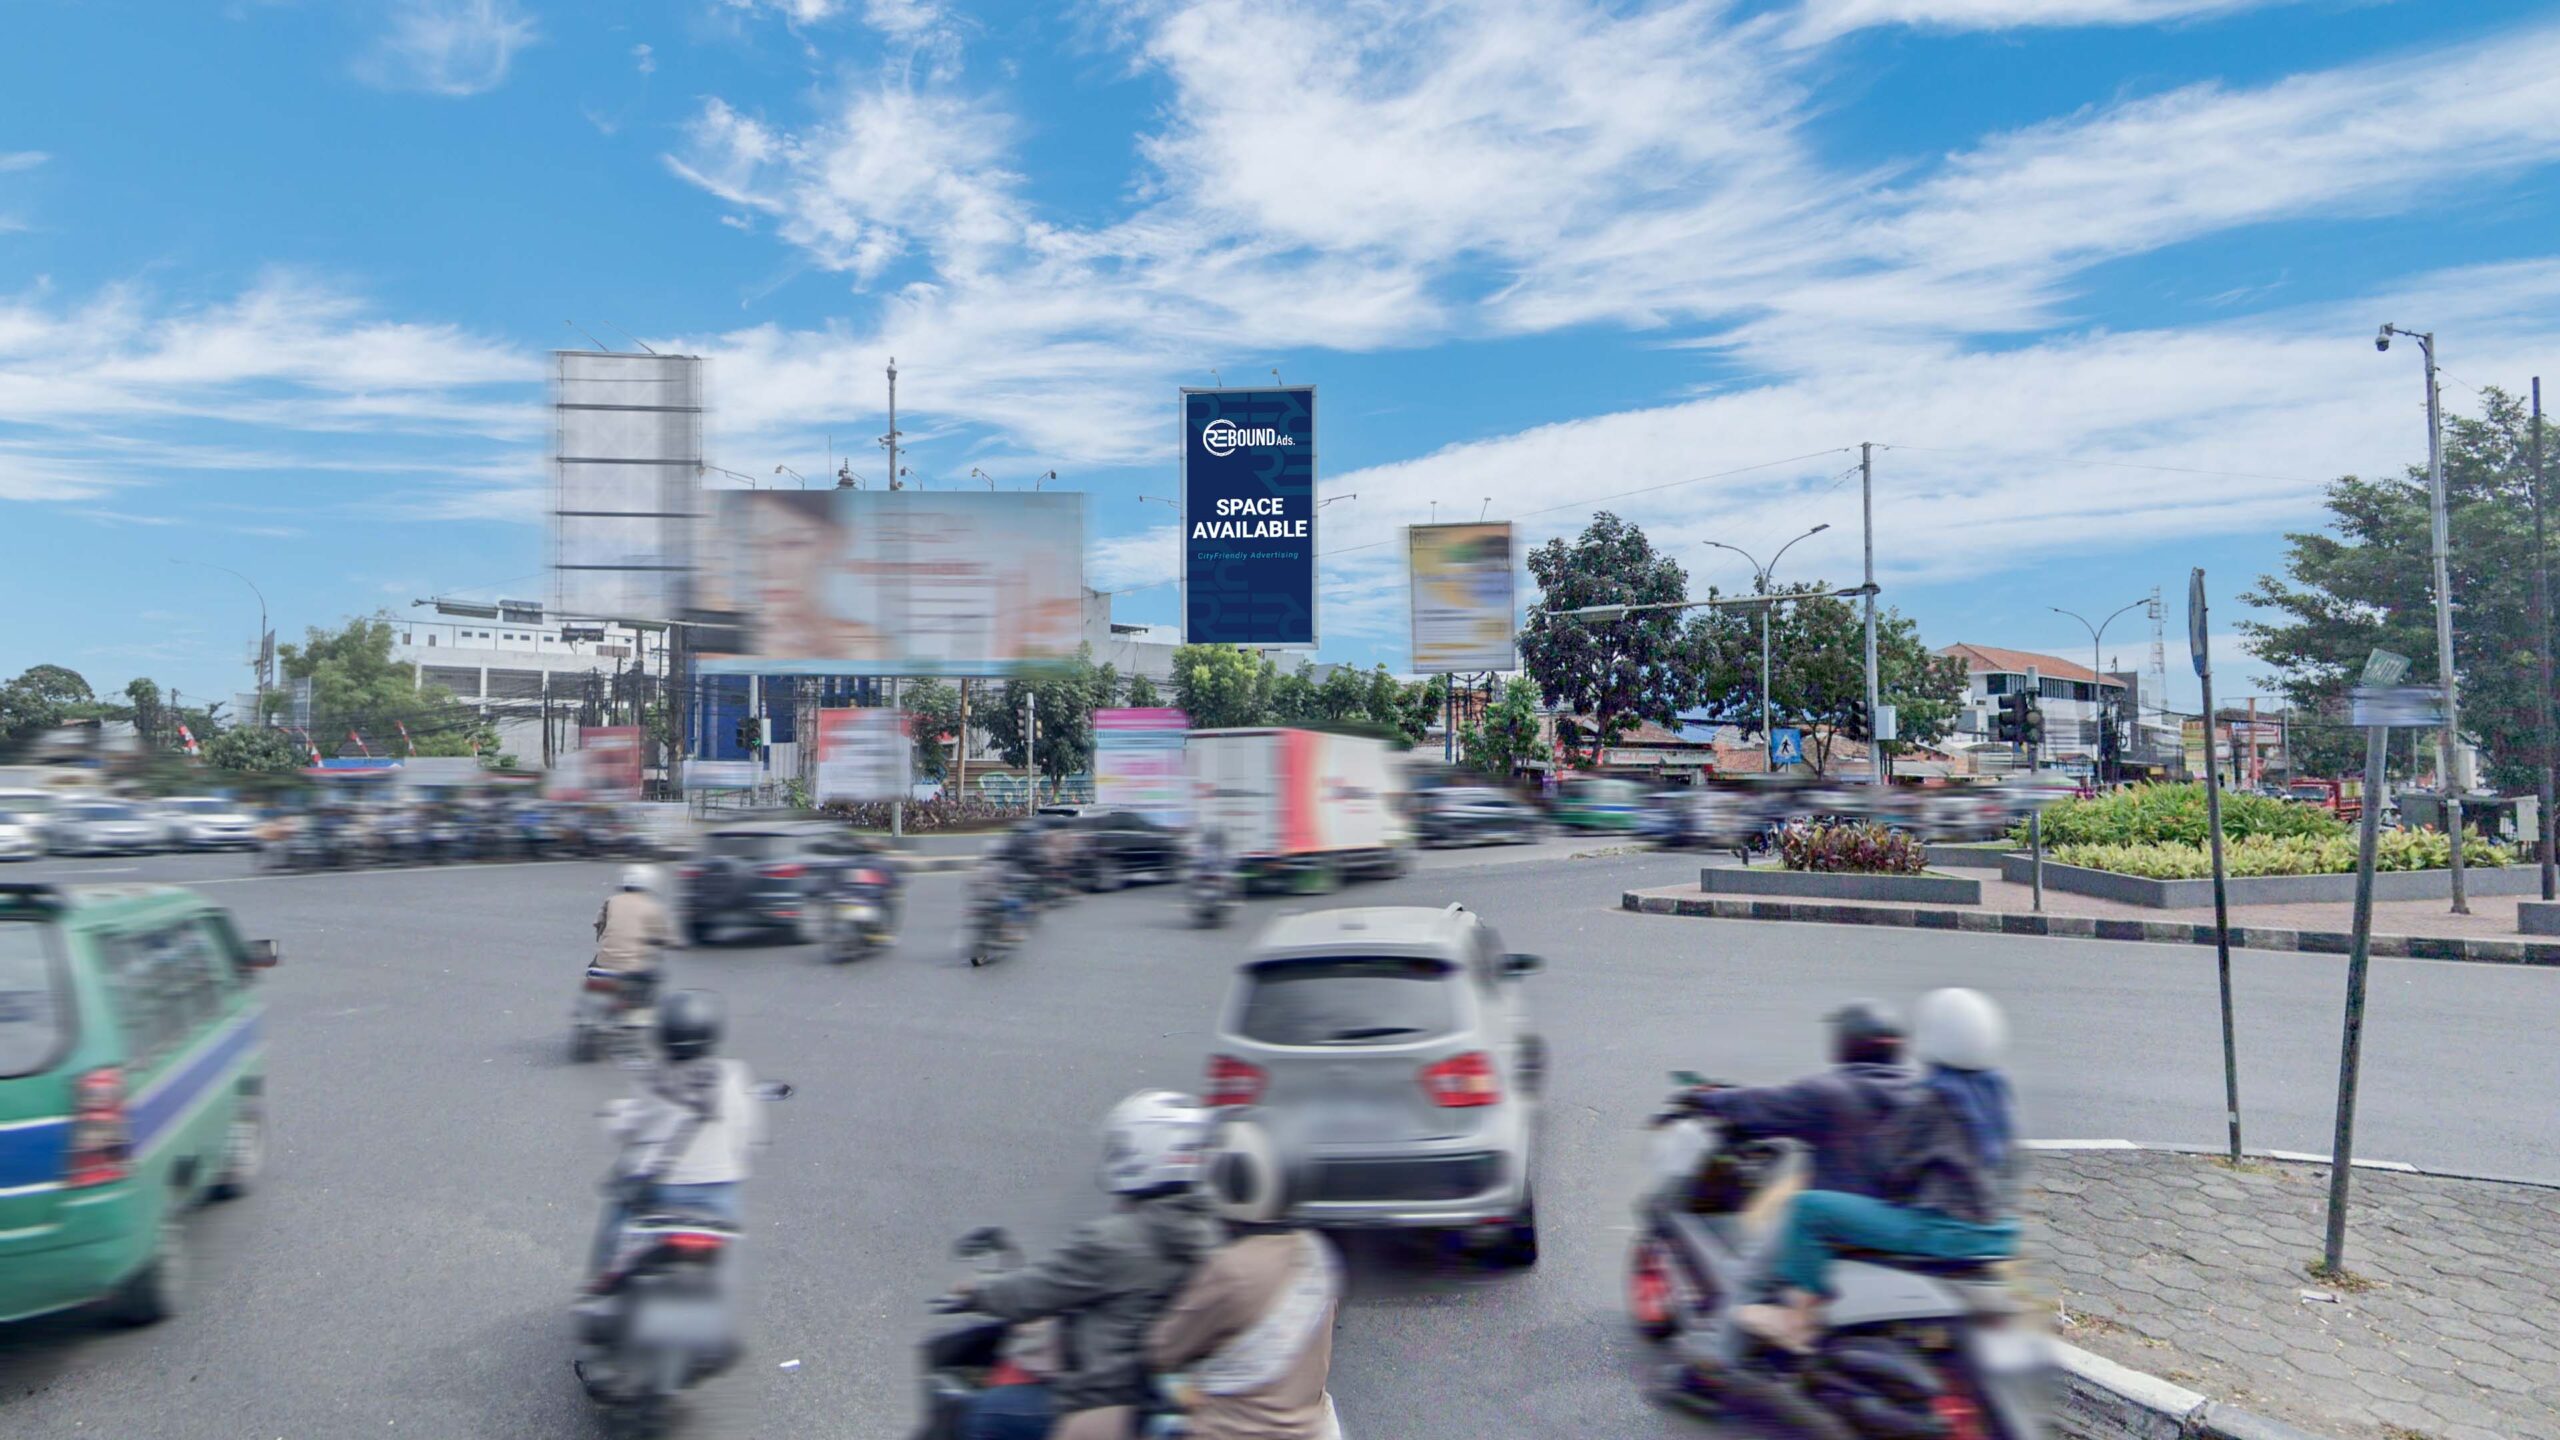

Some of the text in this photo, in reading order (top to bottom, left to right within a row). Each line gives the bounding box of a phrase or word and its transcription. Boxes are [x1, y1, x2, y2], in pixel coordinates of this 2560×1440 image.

[1216, 497, 1284, 516] SPACE
[1192, 519, 1307, 539] AVAILABLE
[1197, 551, 1299, 561] CityFriendly Advertising
